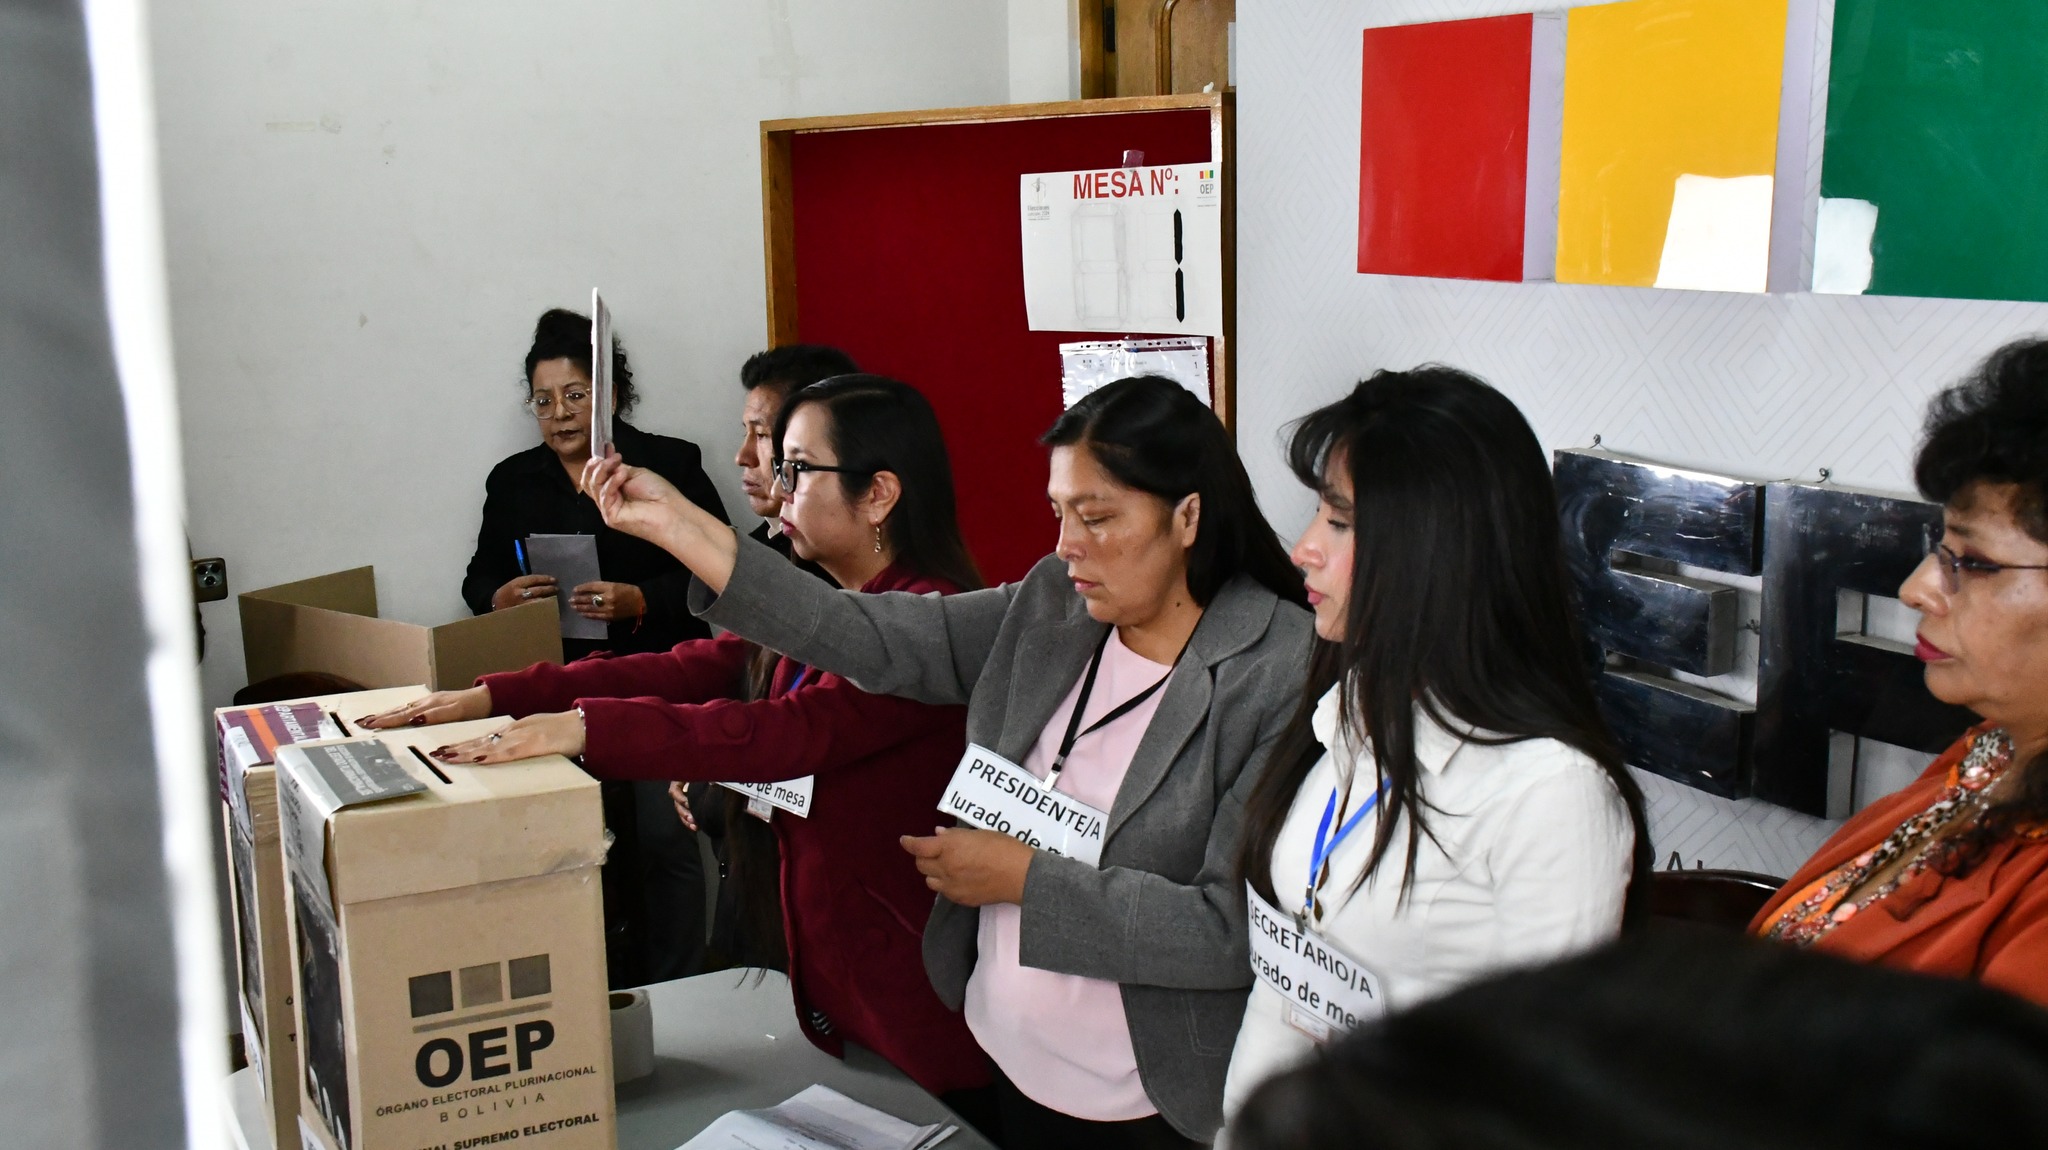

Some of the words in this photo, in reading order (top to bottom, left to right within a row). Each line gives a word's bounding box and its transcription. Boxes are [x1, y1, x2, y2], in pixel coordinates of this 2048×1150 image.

[1073, 170, 1145, 200] MESA
[1199, 183, 1214, 195] OEP
[773, 786, 806, 808] mesa
[968, 758, 1101, 841] PRESIDENTE/A
[1298, 981, 1320, 1009] de
[415, 1019, 555, 1088] OEP
[376, 1098, 429, 1117] ÓRGANO
[432, 1084, 502, 1106] ELECTORAL
[505, 1065, 597, 1091] PLURINACIONAL
[440, 1092, 545, 1123] BOLIVIA
[454, 1129, 519, 1150] SUPREMO
[523, 1113, 600, 1136] ELECTORAL
